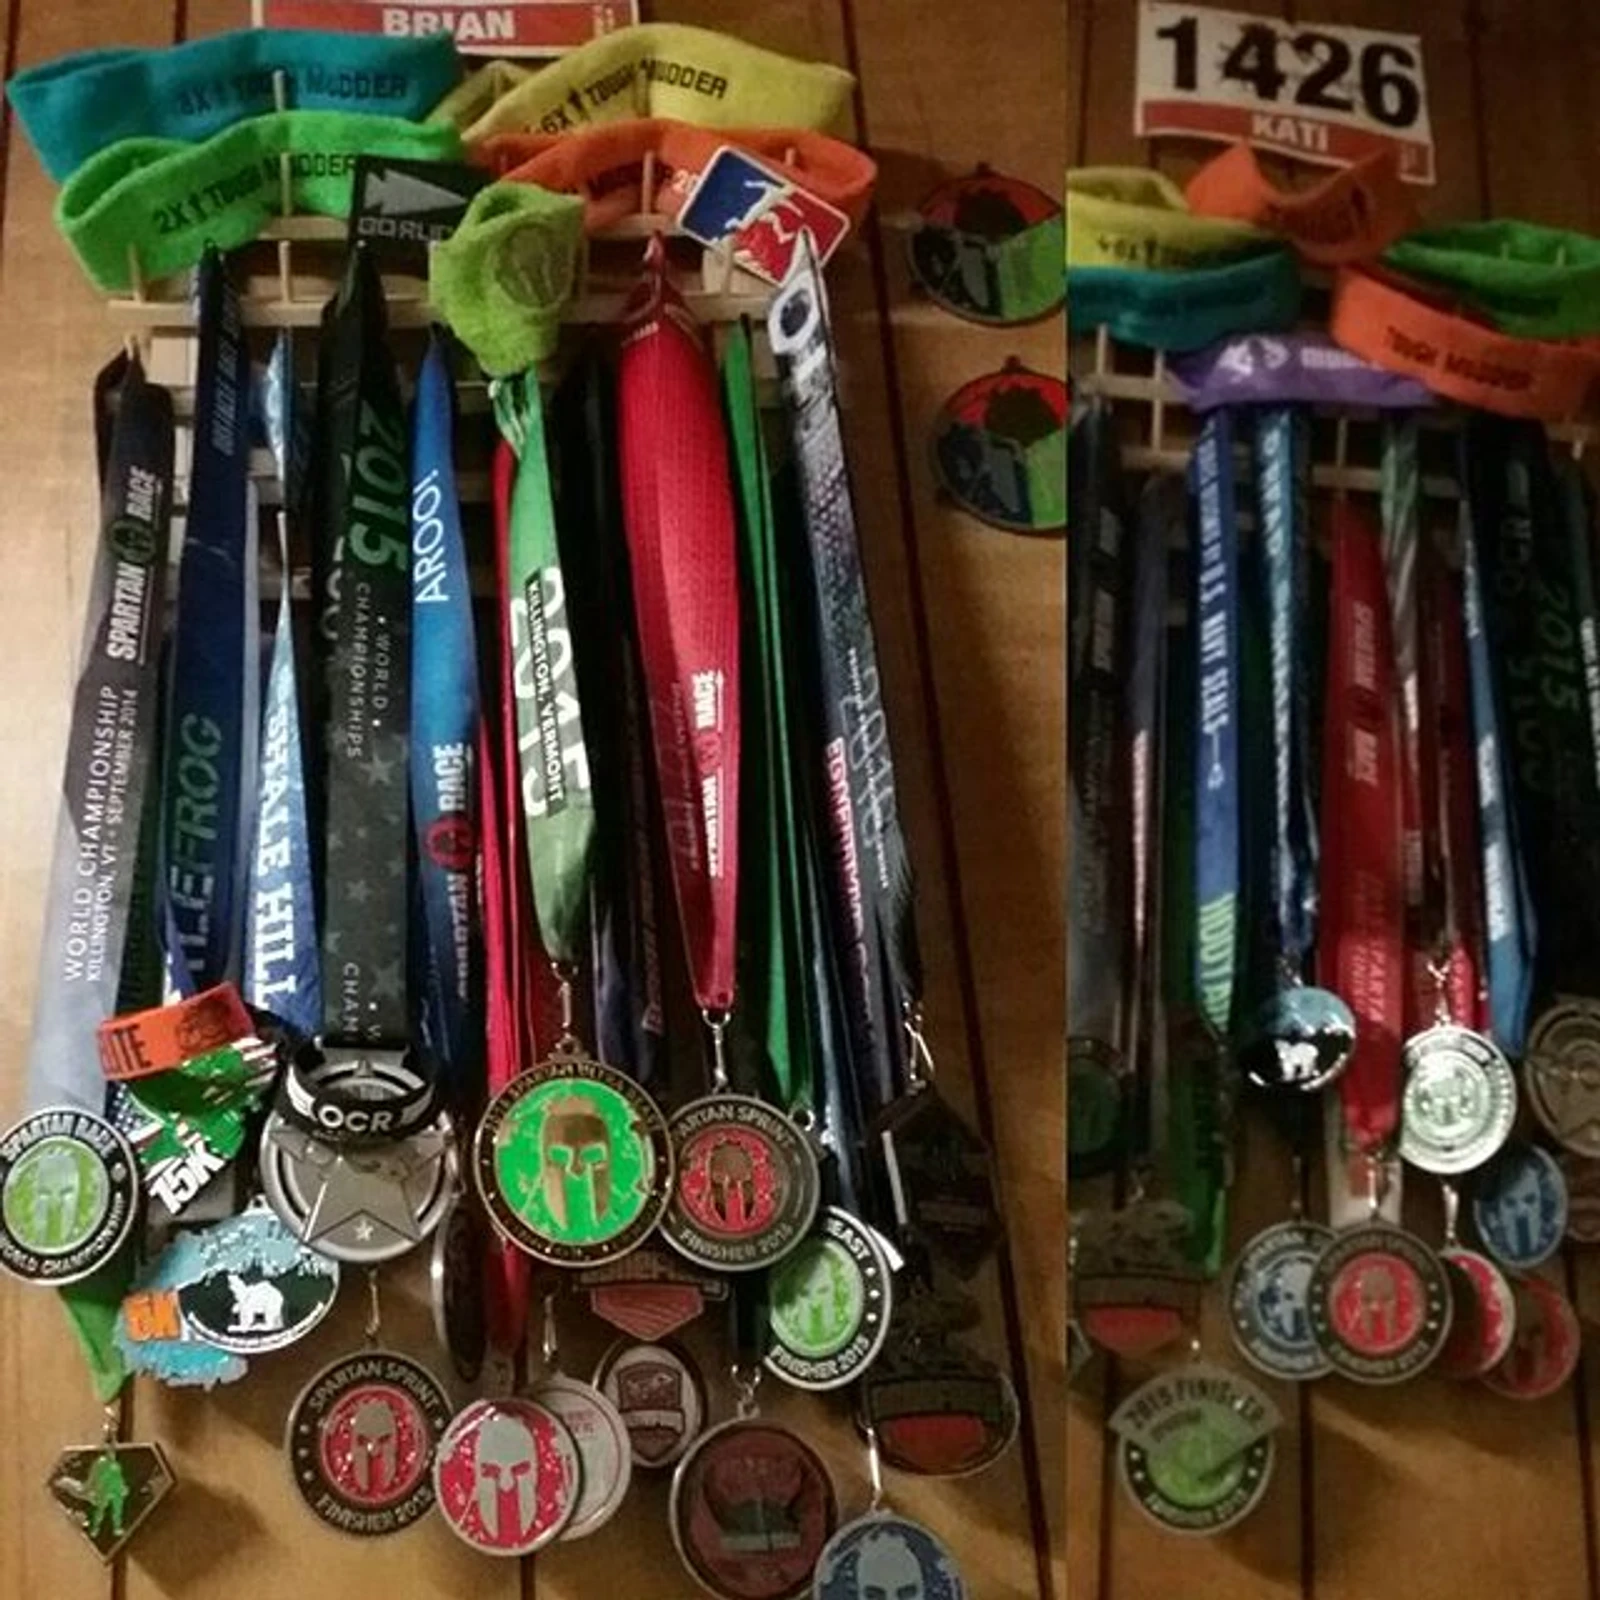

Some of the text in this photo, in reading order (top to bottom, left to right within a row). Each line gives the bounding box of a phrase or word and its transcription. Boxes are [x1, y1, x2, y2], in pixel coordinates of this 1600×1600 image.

[382, 8, 517, 42] BRIAN
[1156, 15, 1421, 129] 1426
[1251, 112, 1330, 153] KATI
[350, 400, 408, 570] 2015
[106, 464, 157, 661] SPARTAN RACE
[413, 468, 450, 604] AROO!
[120, 688, 139, 727] 2014
[347, 581, 372, 758] CHAMPIONSHIPS
[528, 579, 565, 803] KILLINGTON, VERMONT
[107, 728, 136, 826] SEPTEMBER
[433, 742, 468, 812] RACE
[63, 685, 119, 982] WORLD CHAMPIONSHIP
[86, 869, 115, 982] KILLINGTON,
[255, 882, 297, 1011] HILL
[318, 1104, 394, 1133] OCR
[736, 1105, 796, 1149] SPRINT
[148, 1140, 226, 1215] 15K
[309, 1360, 440, 1413] SPARTAN SPRINT
[315, 1491, 395, 1531] FINISHER
